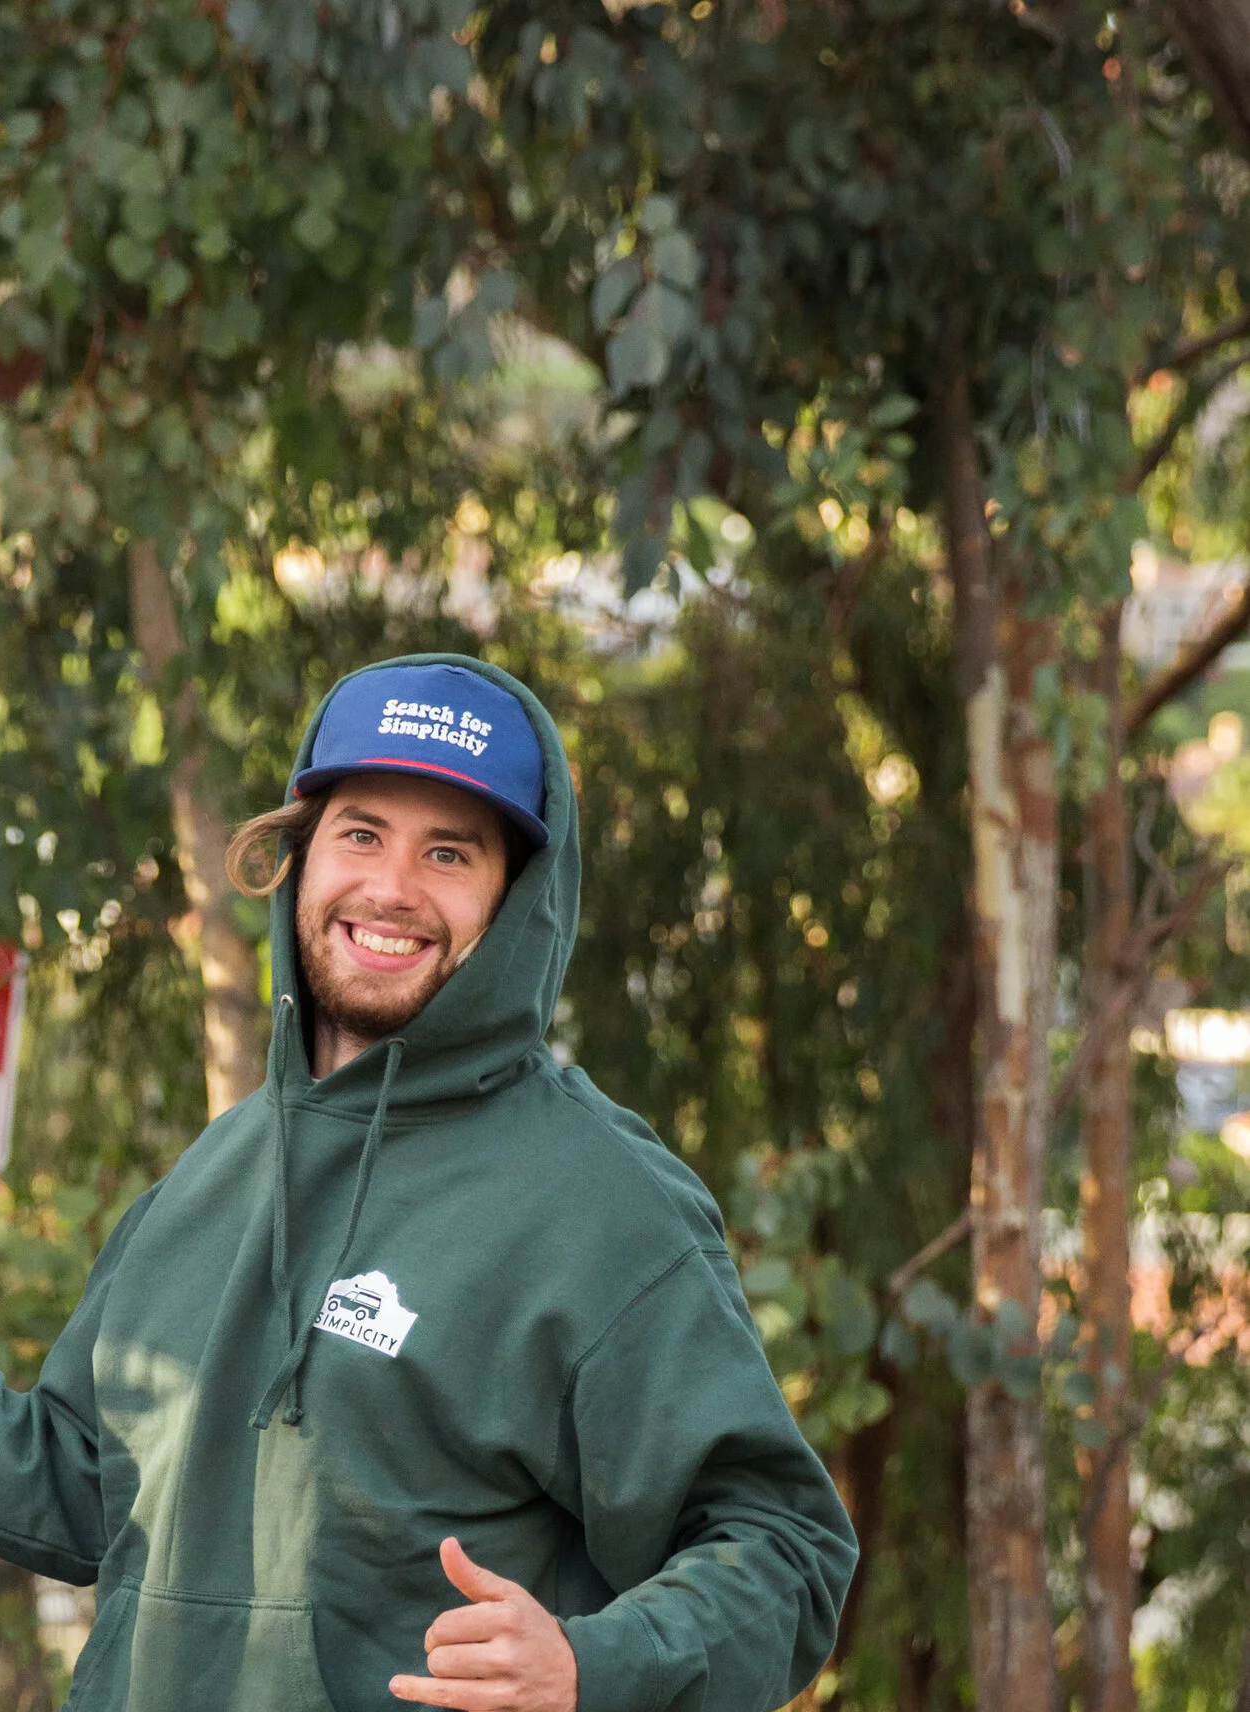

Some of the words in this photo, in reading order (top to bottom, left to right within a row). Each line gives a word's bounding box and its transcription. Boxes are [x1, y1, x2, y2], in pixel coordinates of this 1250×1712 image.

[378, 717, 488, 756] Simplicity
[383, 699, 454, 725] Search
[460, 712, 492, 737] for
[315, 1312, 398, 1351] SIMPLICITY
